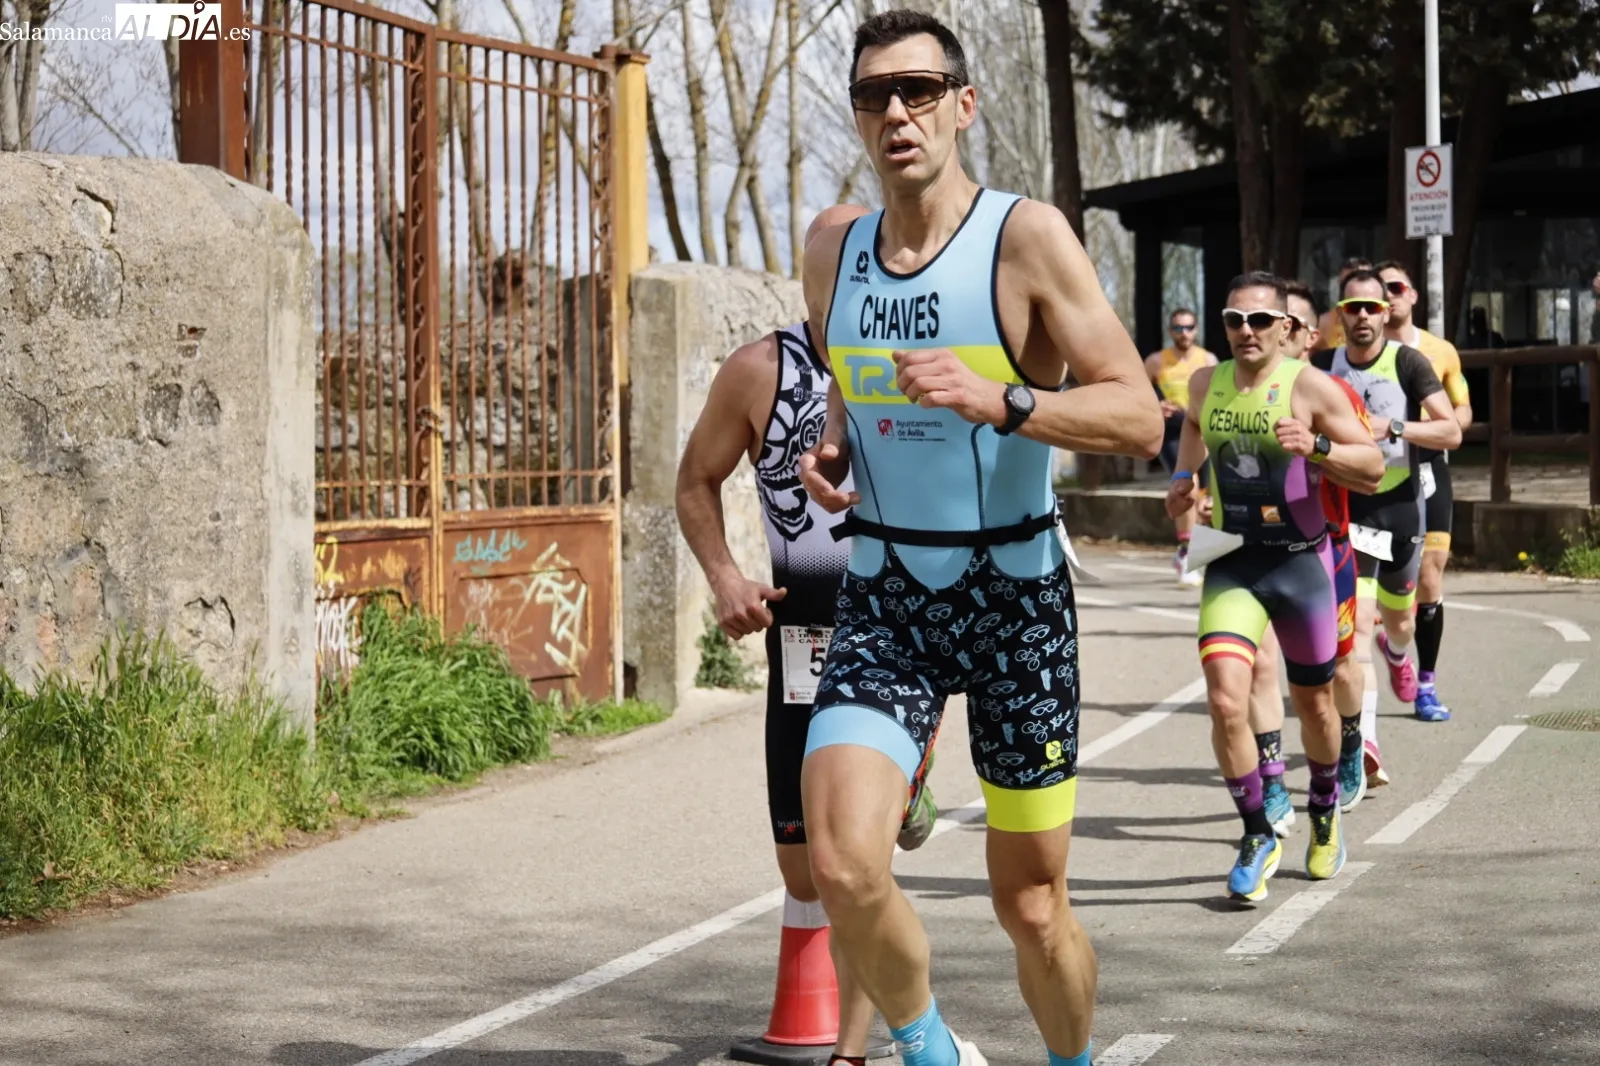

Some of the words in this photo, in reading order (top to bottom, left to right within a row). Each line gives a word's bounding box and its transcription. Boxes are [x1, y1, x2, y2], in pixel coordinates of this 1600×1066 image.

[859, 291, 940, 340] CHAVES
[896, 420, 943, 428] Ayuntamiento
[1208, 408, 1269, 435] CEBALLOS
[898, 429, 906, 437] de
[907, 428, 925, 437] Ávila
